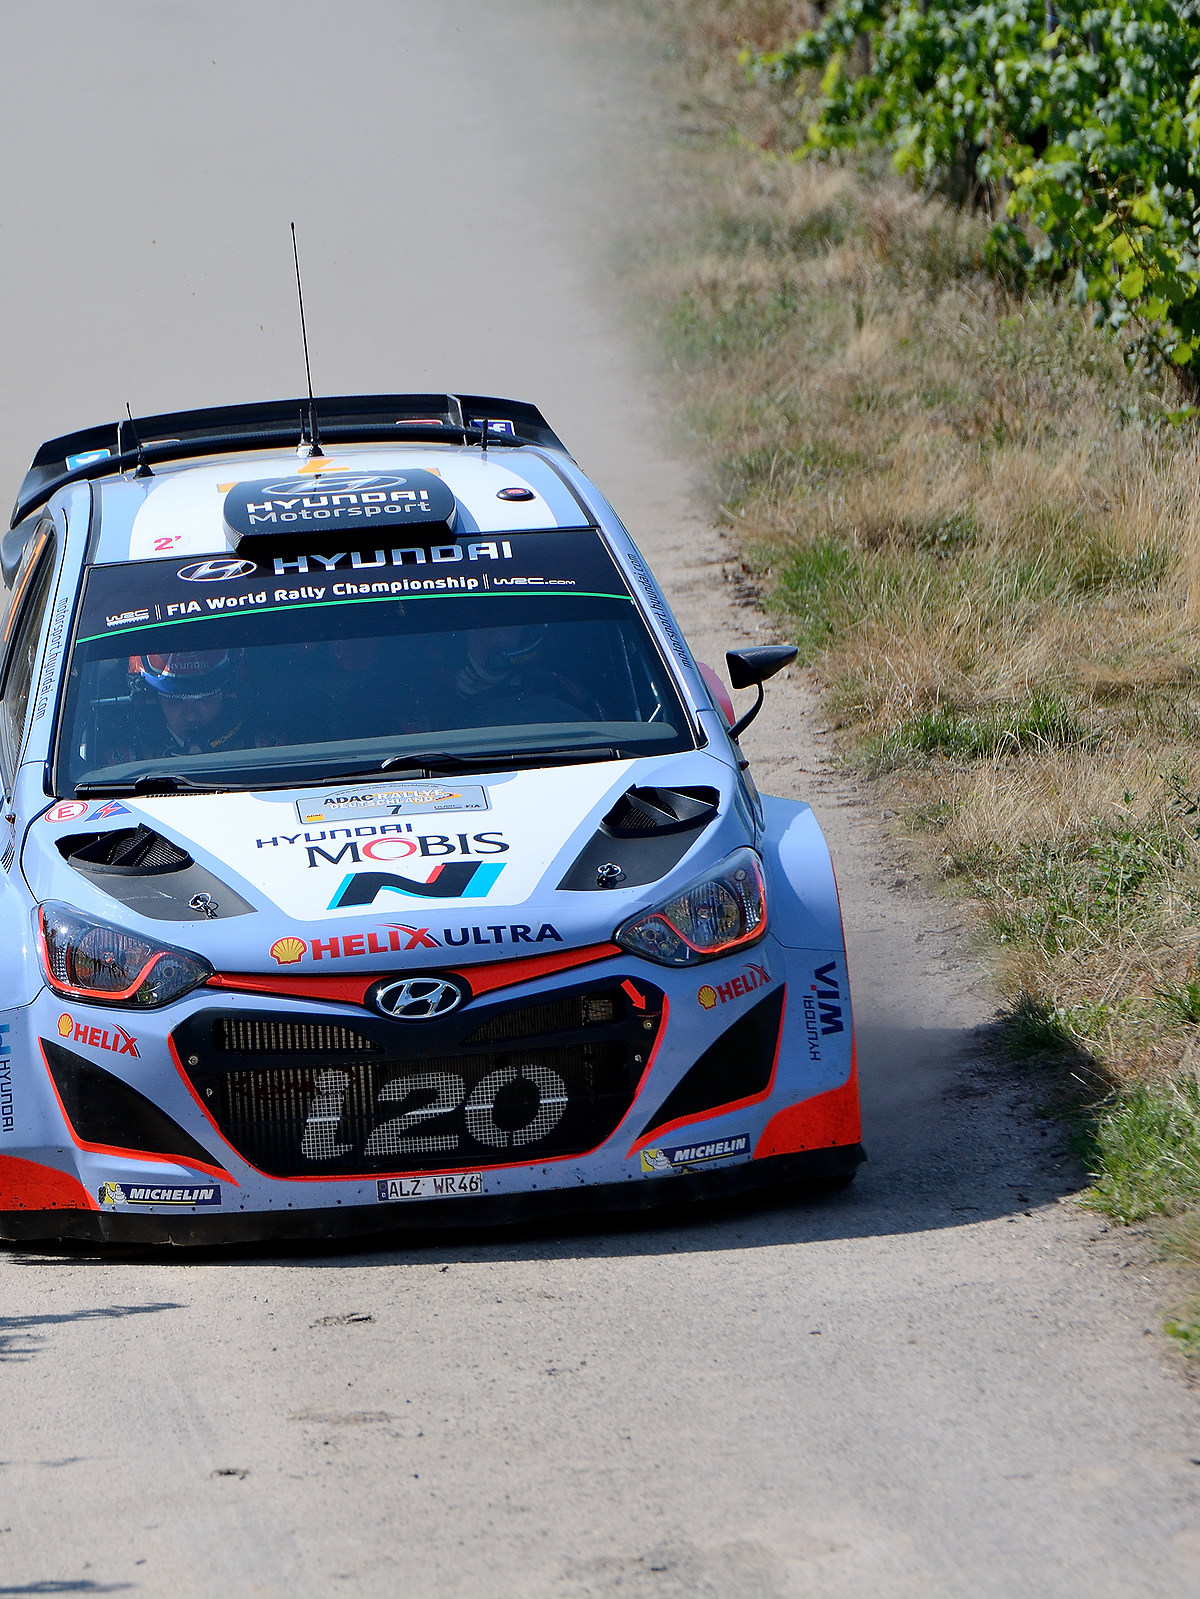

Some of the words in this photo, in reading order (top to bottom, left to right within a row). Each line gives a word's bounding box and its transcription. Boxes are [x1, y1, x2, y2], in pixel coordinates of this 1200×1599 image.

[247, 490, 429, 513] HYUNDAI
[249, 501, 431, 525] Motorsport
[273, 541, 513, 575] HYUNDAI
[167, 601, 201, 617] FIA
[206, 592, 267, 611] World
[274, 585, 326, 602] Rally
[332, 576, 479, 596] Championship
[627, 553, 693, 669] motorsport.hyundai.com
[35, 597, 69, 721] motorsport.hyundai.com
[323, 794, 374, 805] ADAC
[377, 789, 447, 800] RALLYE
[330, 796, 433, 810] DEUTSCHLAND
[386, 804, 403, 815] 7
[57, 805, 74, 819] E
[256, 823, 413, 848] HYUNDAI
[305, 832, 509, 868] MOBIS
[309, 923, 443, 960] HELIX
[443, 923, 564, 947] ULTRA
[716, 964, 772, 1004] HELIX
[74, 1023, 142, 1060] HELIX
[803, 995, 821, 1061] HYUNDAI
[301, 1064, 568, 1160] i20
[673, 1137, 746, 1162] MICHELIN
[129, 1187, 214, 1200] MICHELIN
[390, 1180, 422, 1198] ALZ
